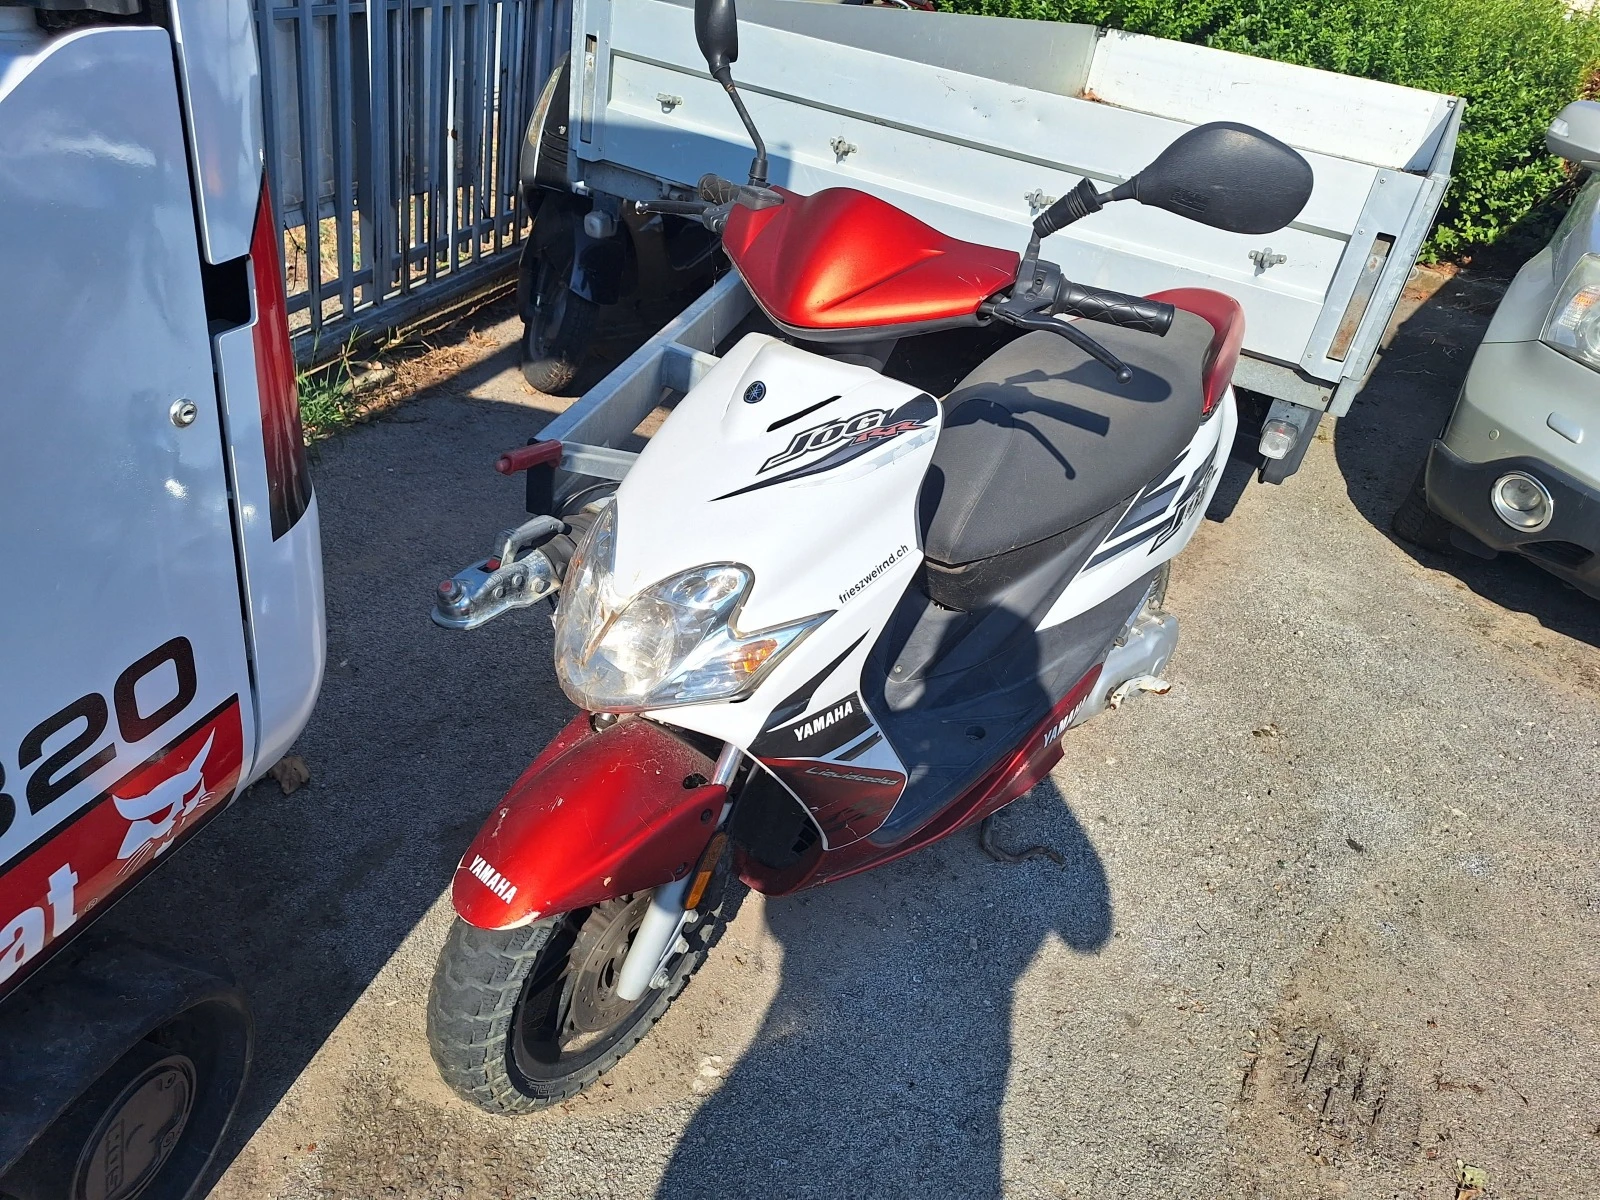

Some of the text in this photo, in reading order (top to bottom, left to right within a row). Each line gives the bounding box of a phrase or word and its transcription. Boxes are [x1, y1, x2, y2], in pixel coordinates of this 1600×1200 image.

[756, 408, 894, 476] JOG
[0, 636, 197, 838] 20
[794, 701, 853, 742] YAMAHA
[469, 854, 518, 905] YAMAHA
